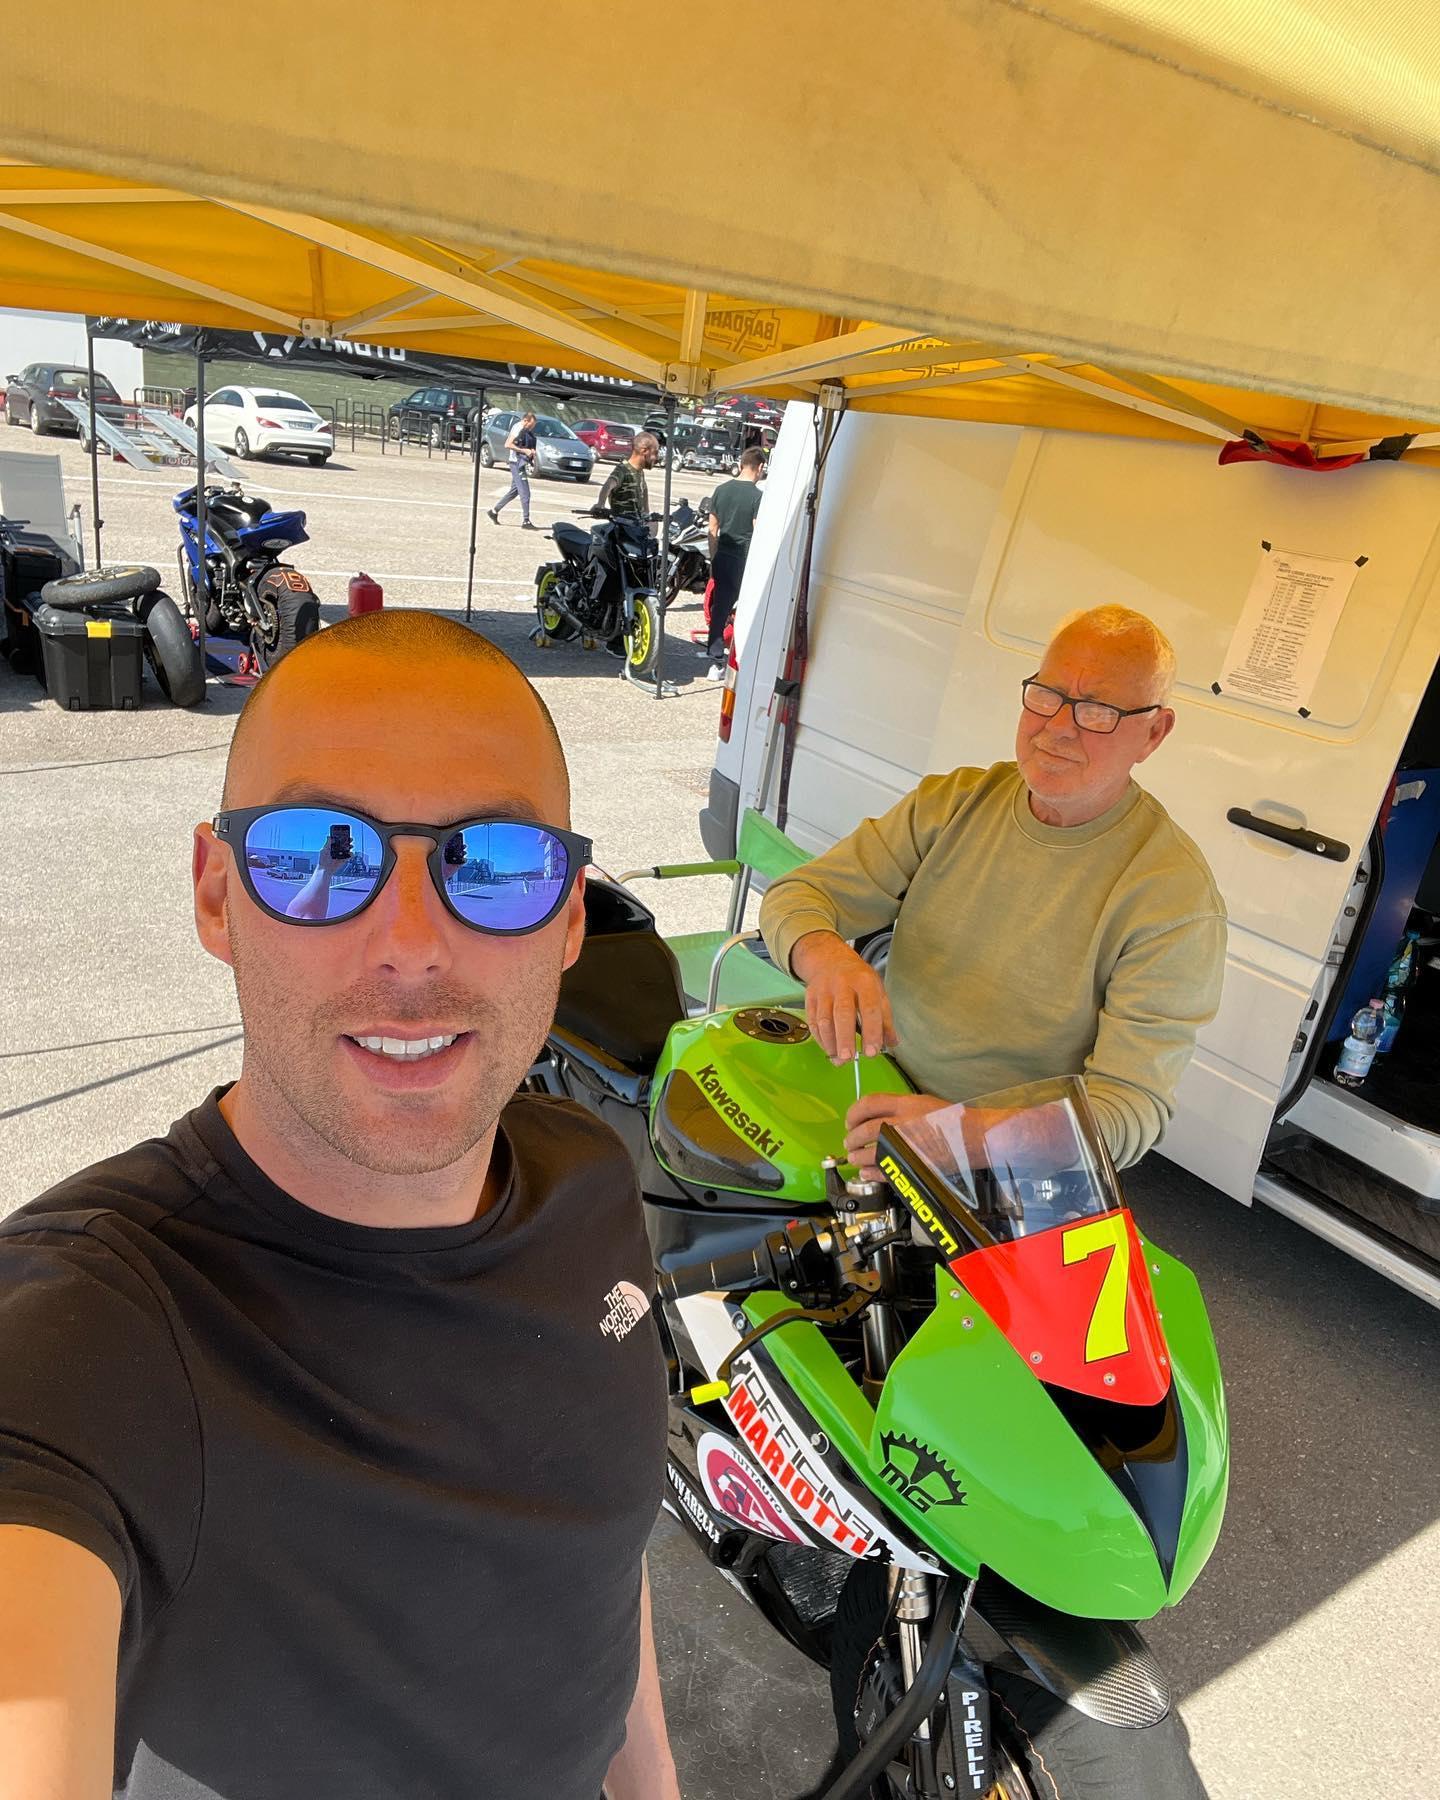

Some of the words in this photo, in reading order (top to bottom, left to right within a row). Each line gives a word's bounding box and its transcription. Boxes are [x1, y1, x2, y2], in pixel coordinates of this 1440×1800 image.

[696, 1064, 784, 1158] Kawasaki
[599, 1297, 631, 1337] NORTH
[603, 1285, 624, 1310] THE
[613, 1311, 637, 1343] FACE
[1061, 1212, 1131, 1365] 7
[667, 1462, 720, 1544] VIVARELLI
[727, 1382, 869, 1556] MARIOTTI
[731, 1448, 783, 1514] TUTTAUTO
[961, 1691, 985, 1790] PIRELLI
